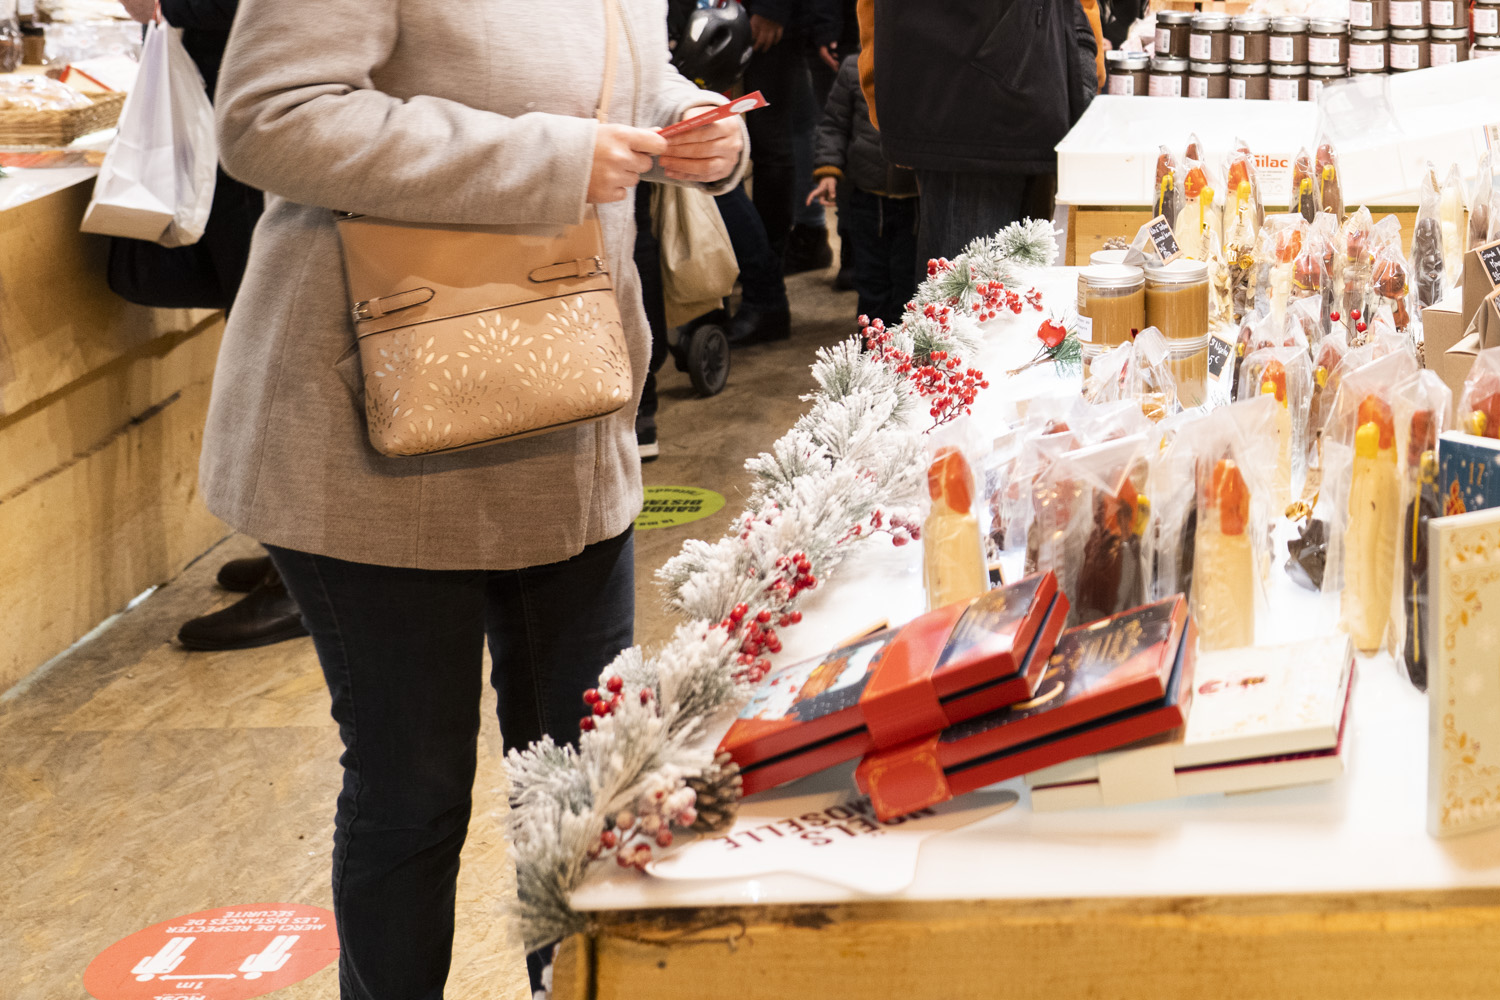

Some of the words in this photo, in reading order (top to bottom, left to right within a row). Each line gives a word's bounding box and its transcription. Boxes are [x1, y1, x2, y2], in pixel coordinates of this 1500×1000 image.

[1468, 461, 1486, 486] 17
[185, 918, 207, 926] DE
[208, 917, 291, 926] DISTANCES
[292, 916, 321, 925] LES
[165, 925, 252, 934] RESPECTER
[253, 924, 274, 932] DE
[278, 923, 327, 932] MERCI
[175, 981, 204, 990] 1m
